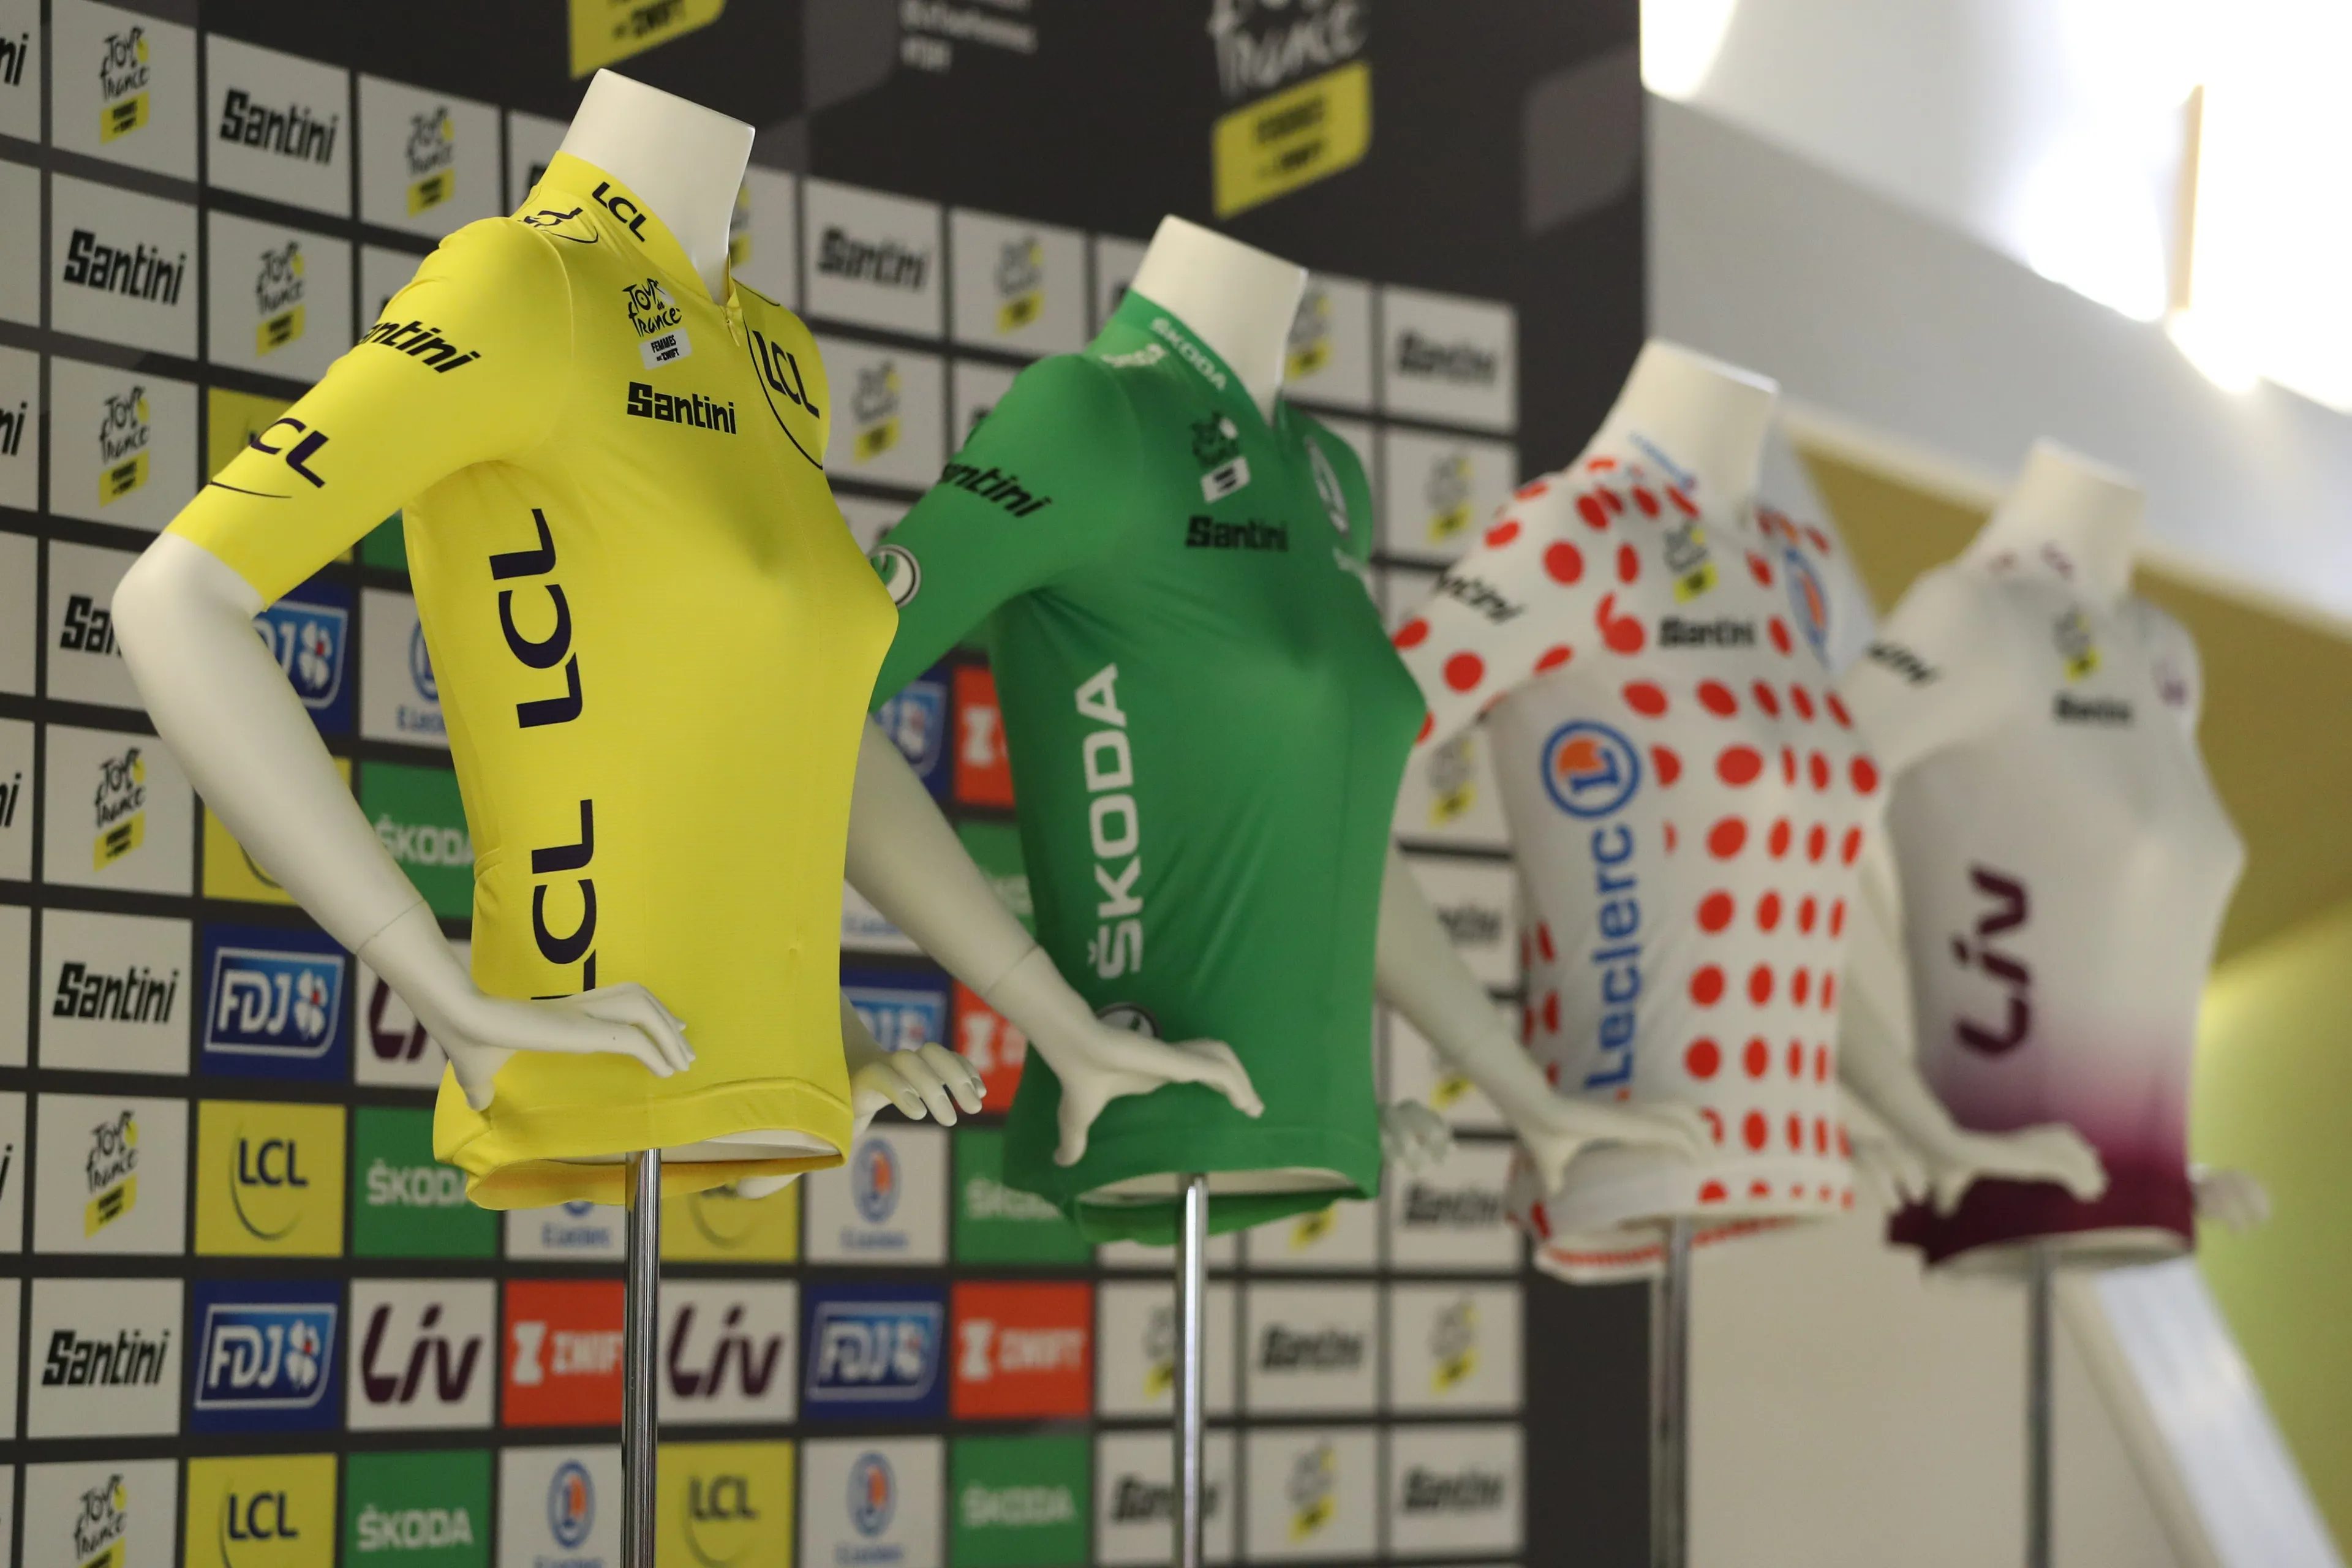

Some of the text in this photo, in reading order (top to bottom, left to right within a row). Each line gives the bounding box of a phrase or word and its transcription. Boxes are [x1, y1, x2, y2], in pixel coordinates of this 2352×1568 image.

[219, 88, 339, 165] Santini
[592, 181, 646, 242] LCL
[63, 228, 187, 306] Santini
[358, 320, 481, 374] antini
[650, 334, 676, 353] FEMMES
[752, 330, 820, 419] LCL
[627, 382, 736, 435] Santini
[251, 418, 329, 488] CL
[1186, 515, 1289, 552] Santini
[489, 508, 582, 728] LCL
[374, 813, 473, 867] ŠKOD
[1074, 663, 1144, 979] ŠKODA
[1584, 823, 1643, 1090] Leclerc
[53, 961, 179, 1023] Santini
[217, 968, 292, 1035] FDJ
[238, 1137, 310, 1188] LCL
[366, 1157, 469, 1207] ŠKOD
[41, 1329, 171, 1386] Santini
[207, 1324, 285, 1389] FDJ
[362, 1303, 482, 1403] Liv
[665, 1304, 783, 1399] Liv
[228, 1491, 299, 1540] LCL
[357, 1502, 473, 1551] ŠKODA
